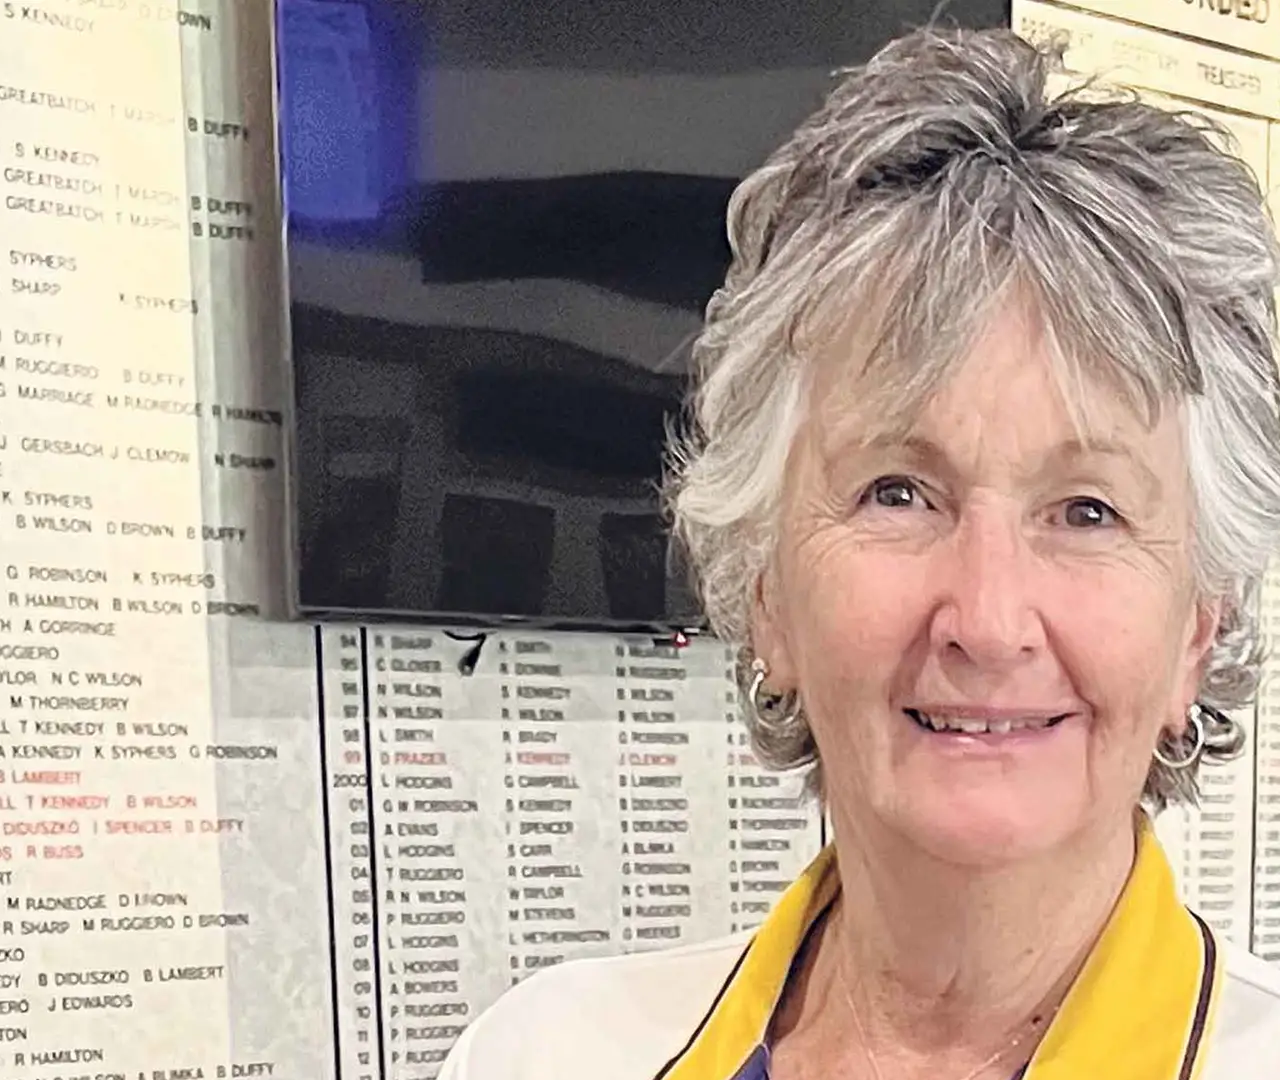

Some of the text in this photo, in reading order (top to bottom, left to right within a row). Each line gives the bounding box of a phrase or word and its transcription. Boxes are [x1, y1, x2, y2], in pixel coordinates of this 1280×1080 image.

[10, 250, 77, 271] SYPHERS
[14, 329, 62, 347] DUFFY
[25, 491, 93, 510] SYPHERS
[85, 672, 142, 687] WILSON
[30, 696, 129, 711] THORNBERRY
[159, 966, 224, 981] LAMBERT
[62, 994, 133, 1010] EDWARDS
[31, 1049, 103, 1065] HAMILTON
[232, 1063, 274, 1078] DUFFY
